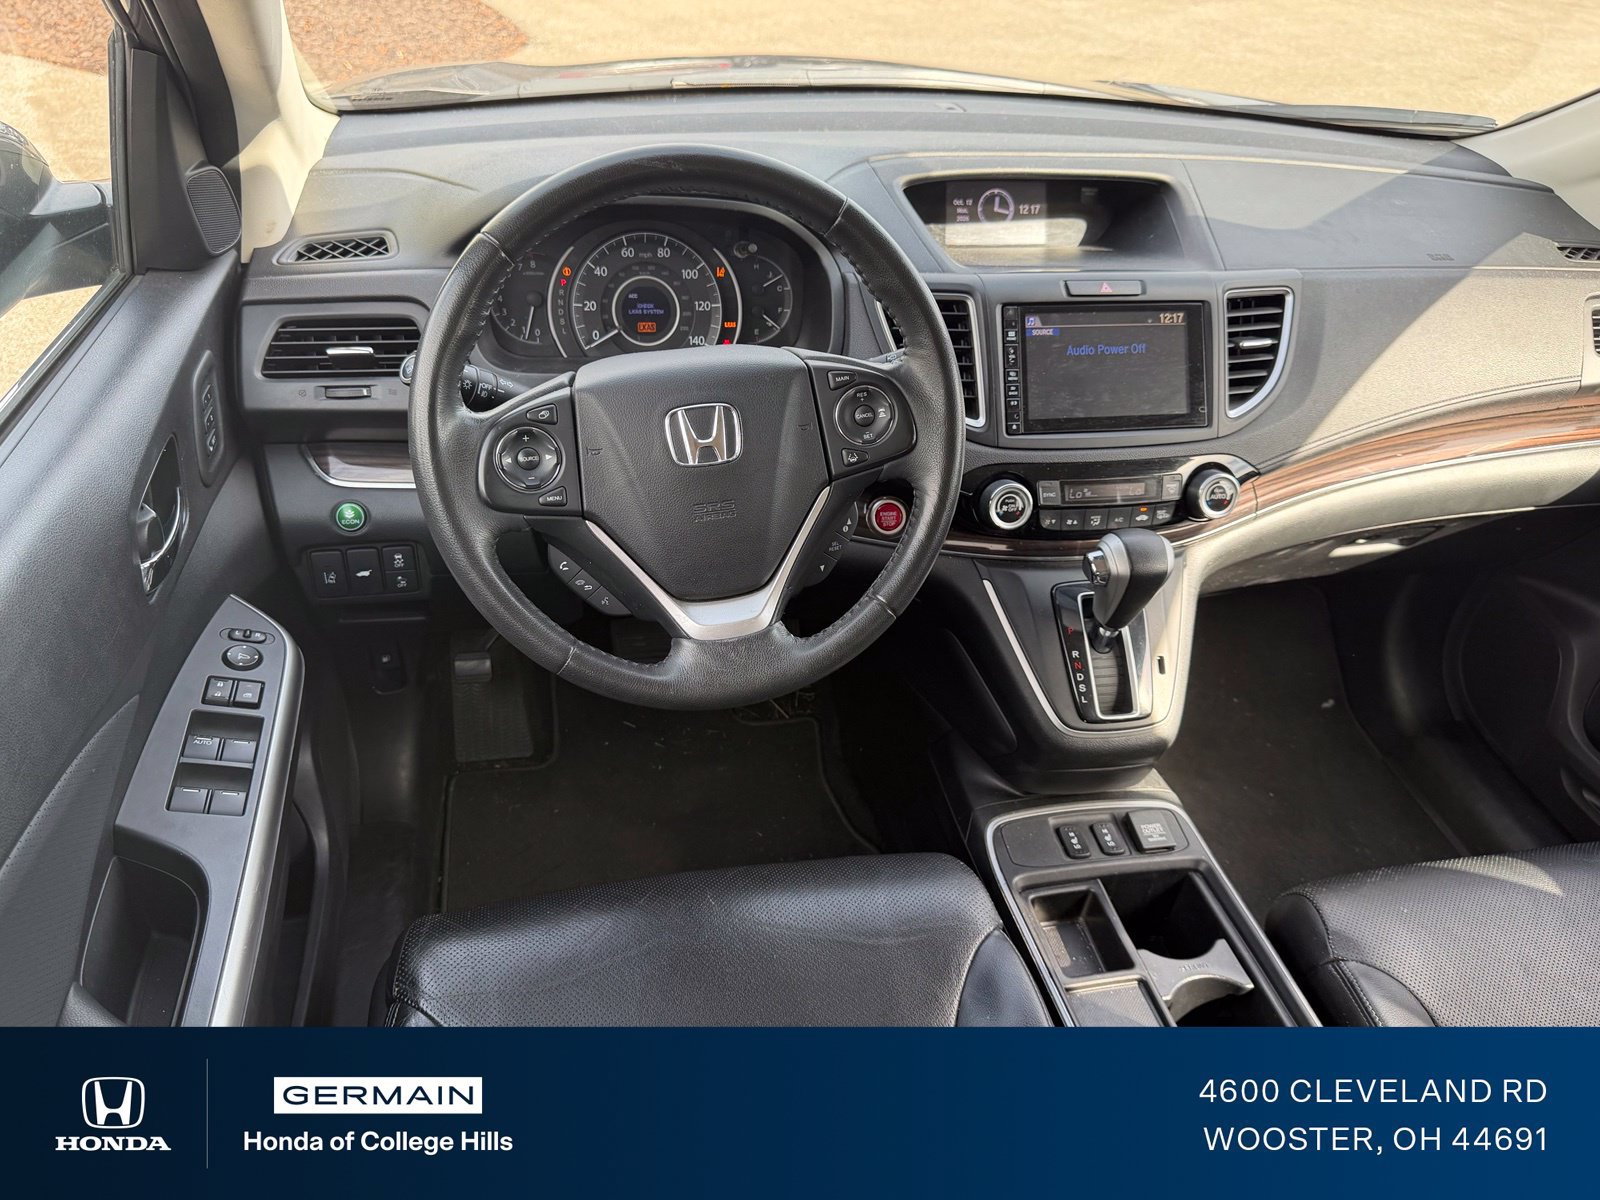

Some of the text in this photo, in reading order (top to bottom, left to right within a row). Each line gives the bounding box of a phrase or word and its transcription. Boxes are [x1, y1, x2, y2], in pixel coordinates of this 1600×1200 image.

[621, 247, 635, 258] 60
[657, 248, 671, 258] 80
[530, 260, 536, 269] 8
[594, 266, 608, 277] 40
[681, 269, 699, 280] 100
[560, 279, 567, 287] P
[583, 301, 597, 311] 20
[694, 301, 711, 311] 120
[511, 318, 517, 327] 2
[1159, 312, 1184, 324] 12:17
[535, 328, 541, 337] 0
[592, 330, 600, 341] 0
[1031, 328, 1054, 336] SOURCE
[688, 336, 705, 346] 140
[1066, 343, 1146, 356] Audio Power Off
[835, 375, 850, 383] MAIN
[481, 382, 493, 390] OFF
[693, 500, 735, 514] SRS
[1066, 626, 1073, 634] P
[1072, 650, 1080, 658] R
[1074, 661, 1082, 669] N
[1076, 673, 1084, 681] D
[1079, 684, 1087, 692] S
[1081, 696, 1088, 704] L
